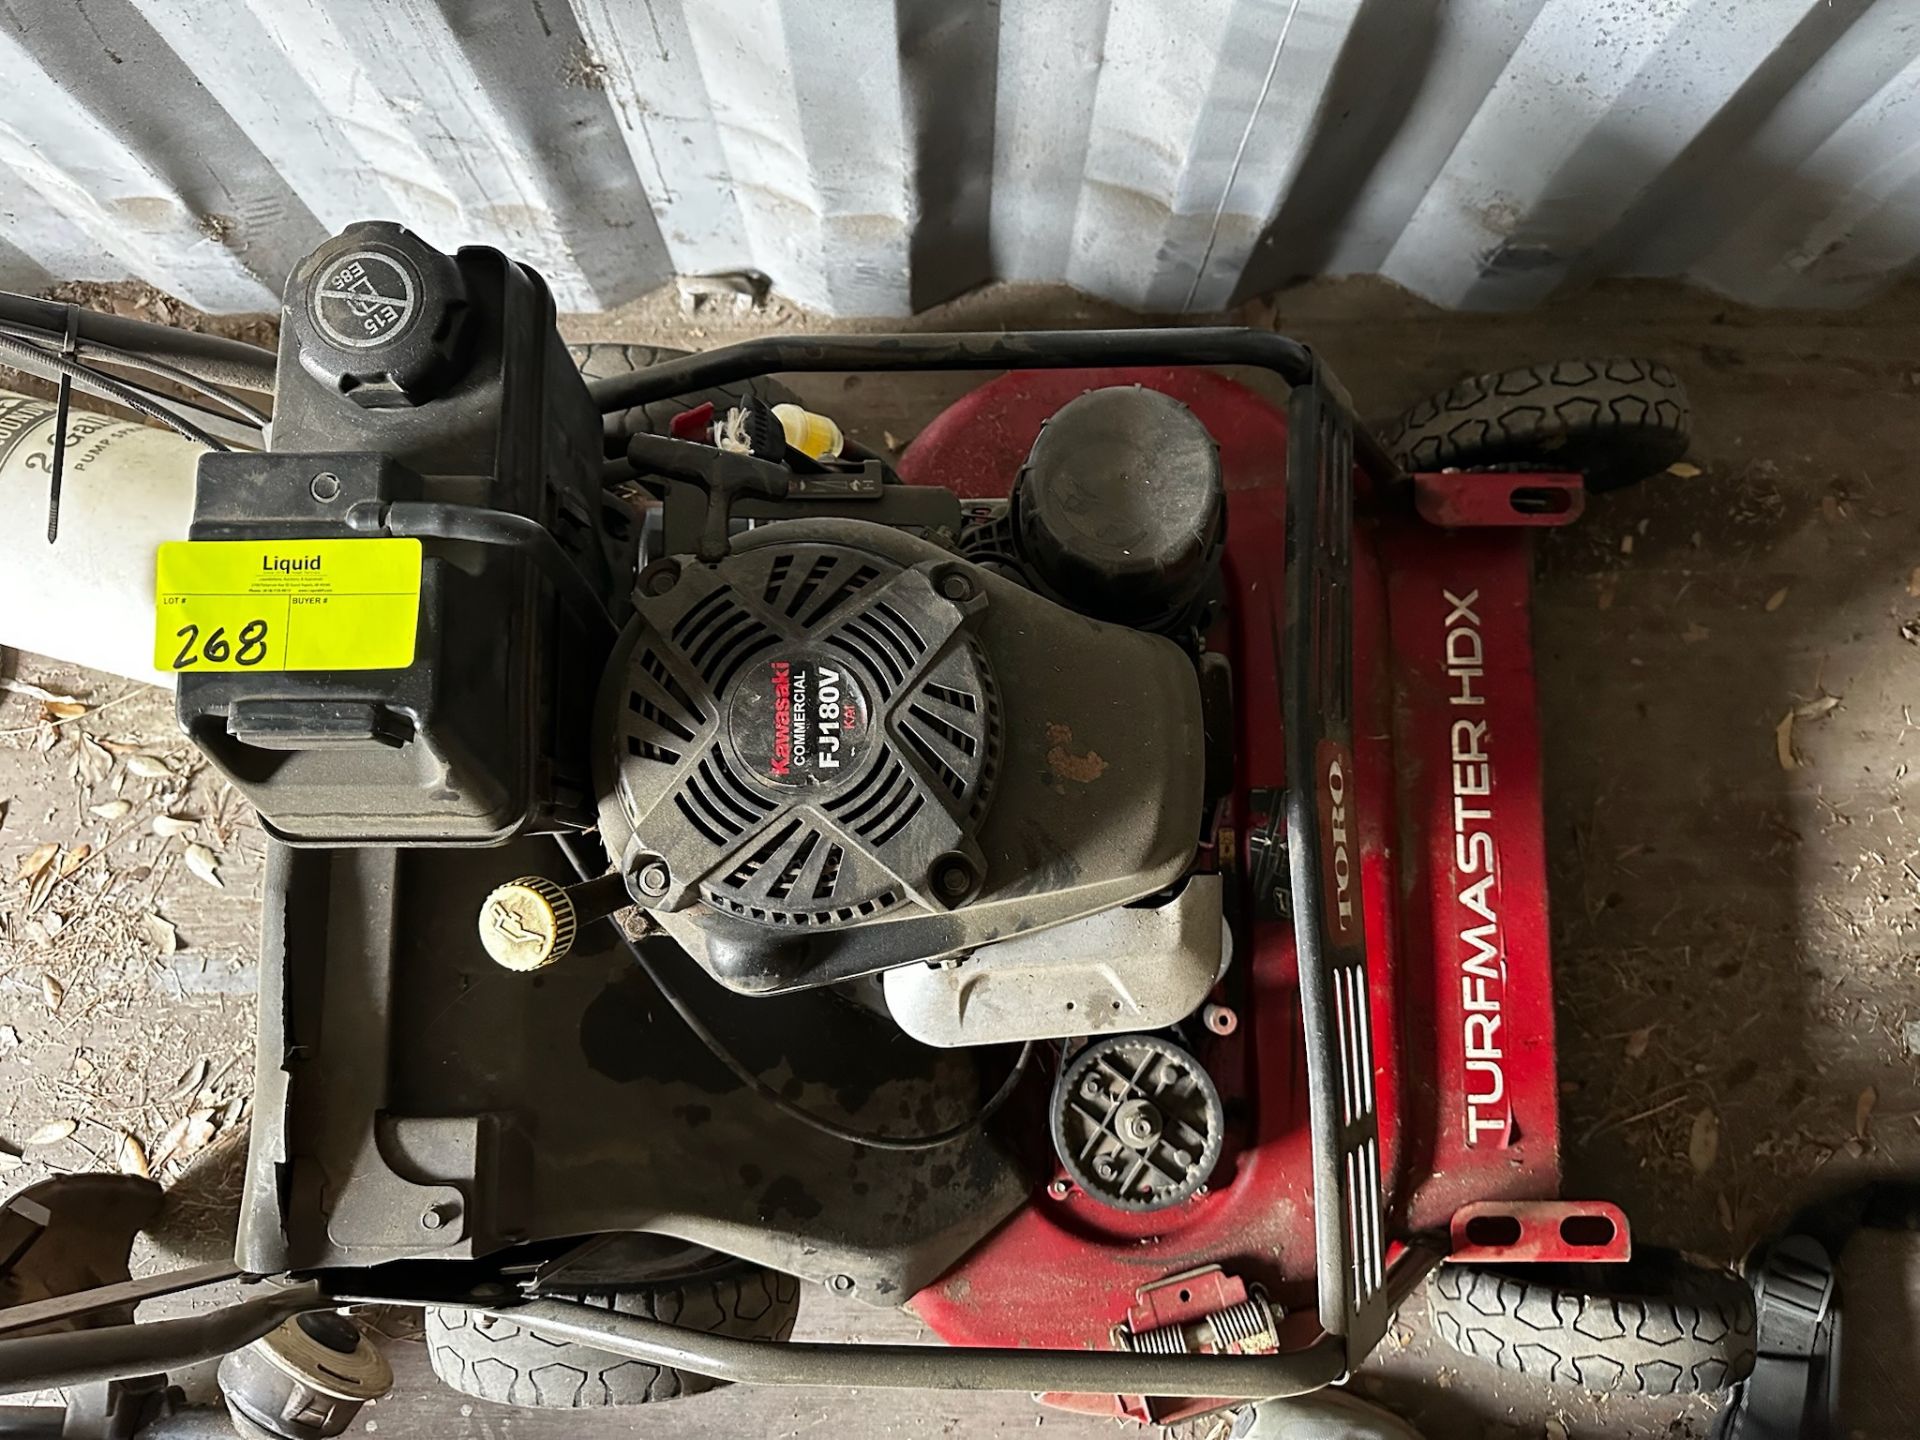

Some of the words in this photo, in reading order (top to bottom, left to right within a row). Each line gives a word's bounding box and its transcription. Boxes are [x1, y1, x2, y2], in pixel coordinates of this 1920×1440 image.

[332, 261, 365, 290] E85
[364, 305, 399, 335] E15
[25, 452, 53, 474] 2
[74, 438, 111, 472] PUMP
[262, 555, 321, 574] Liquid
[164, 597, 179, 605] LOT
[292, 597, 321, 605] BUYER
[172, 619, 268, 669] 268
[1442, 588, 1486, 705] HDX
[770, 660, 790, 775] Kawasaki
[793, 670, 806, 766] COMMERCIAL
[818, 666, 840, 769] FJ180V
[1328, 759, 1353, 931] TORO
[1450, 719, 1506, 1144] TURFMASTER
